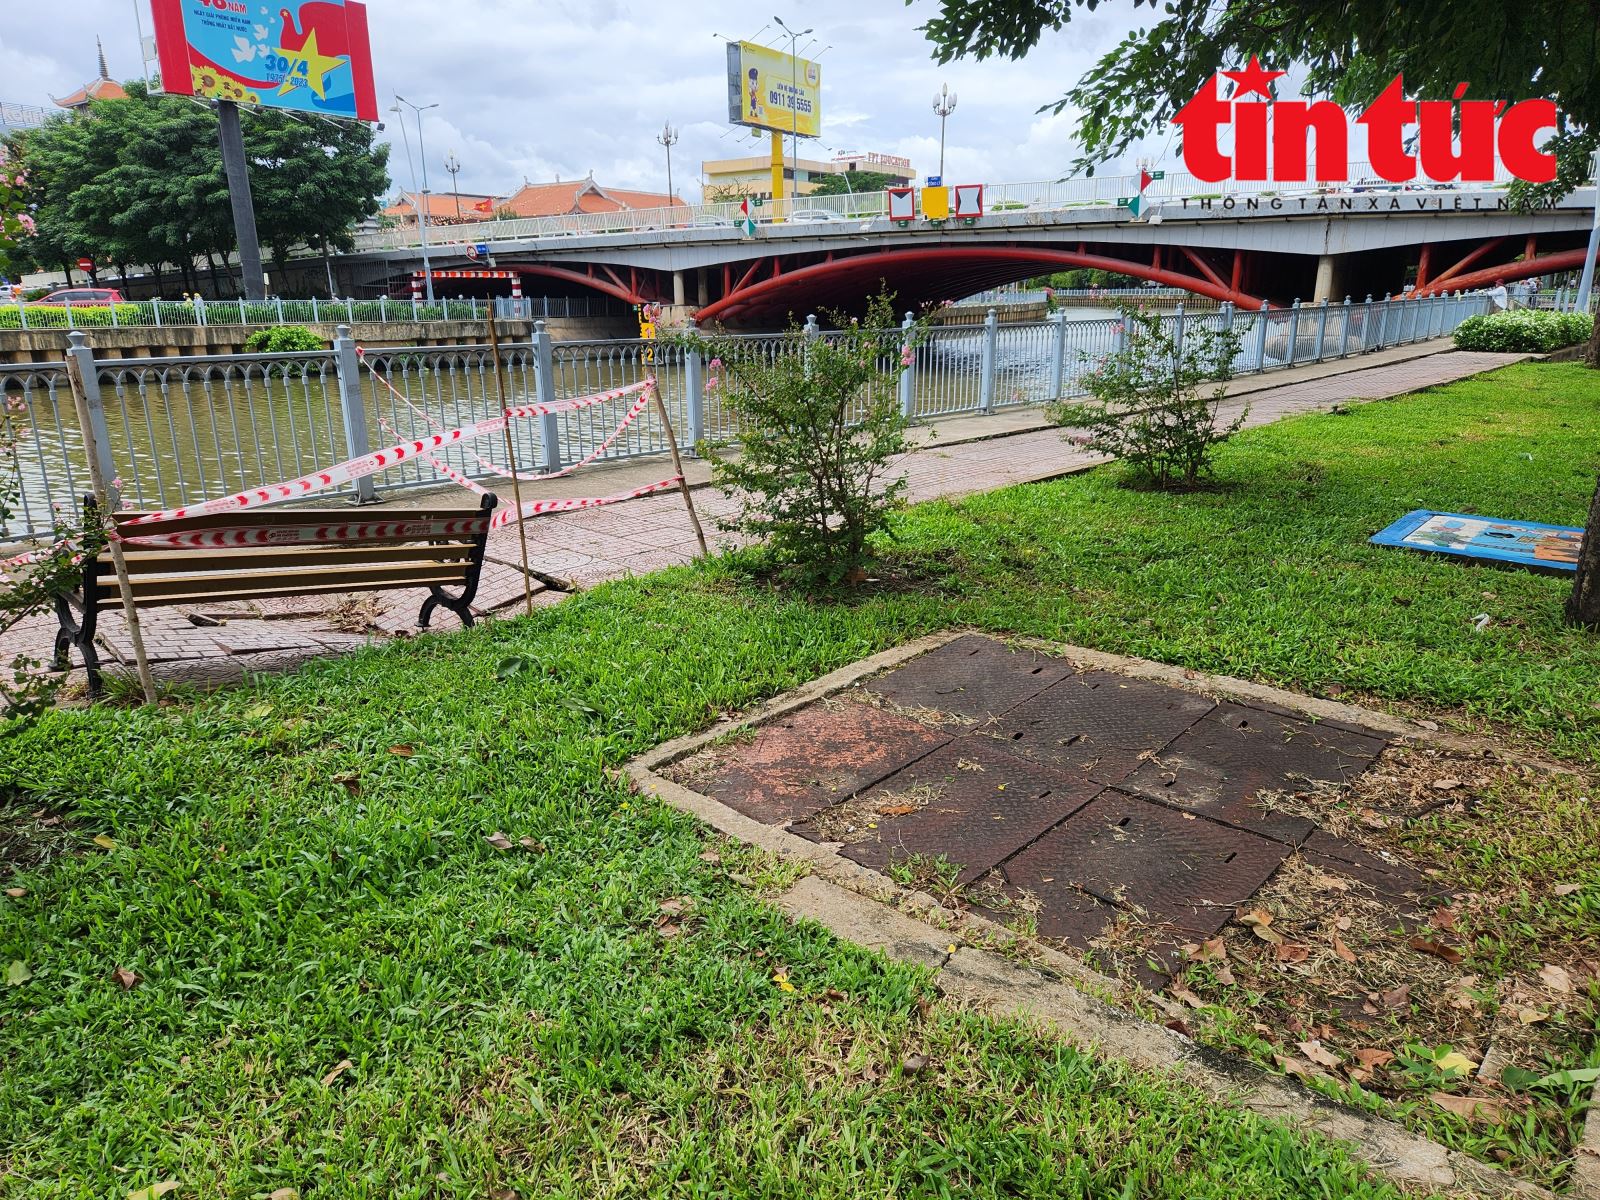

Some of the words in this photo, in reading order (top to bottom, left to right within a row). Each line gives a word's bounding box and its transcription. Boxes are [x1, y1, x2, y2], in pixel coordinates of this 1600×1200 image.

[264, 54, 309, 76] 30/4
[769, 90, 785, 107] 0911
[796, 97, 812, 113] 5555
[647, 348, 654, 362] 2
